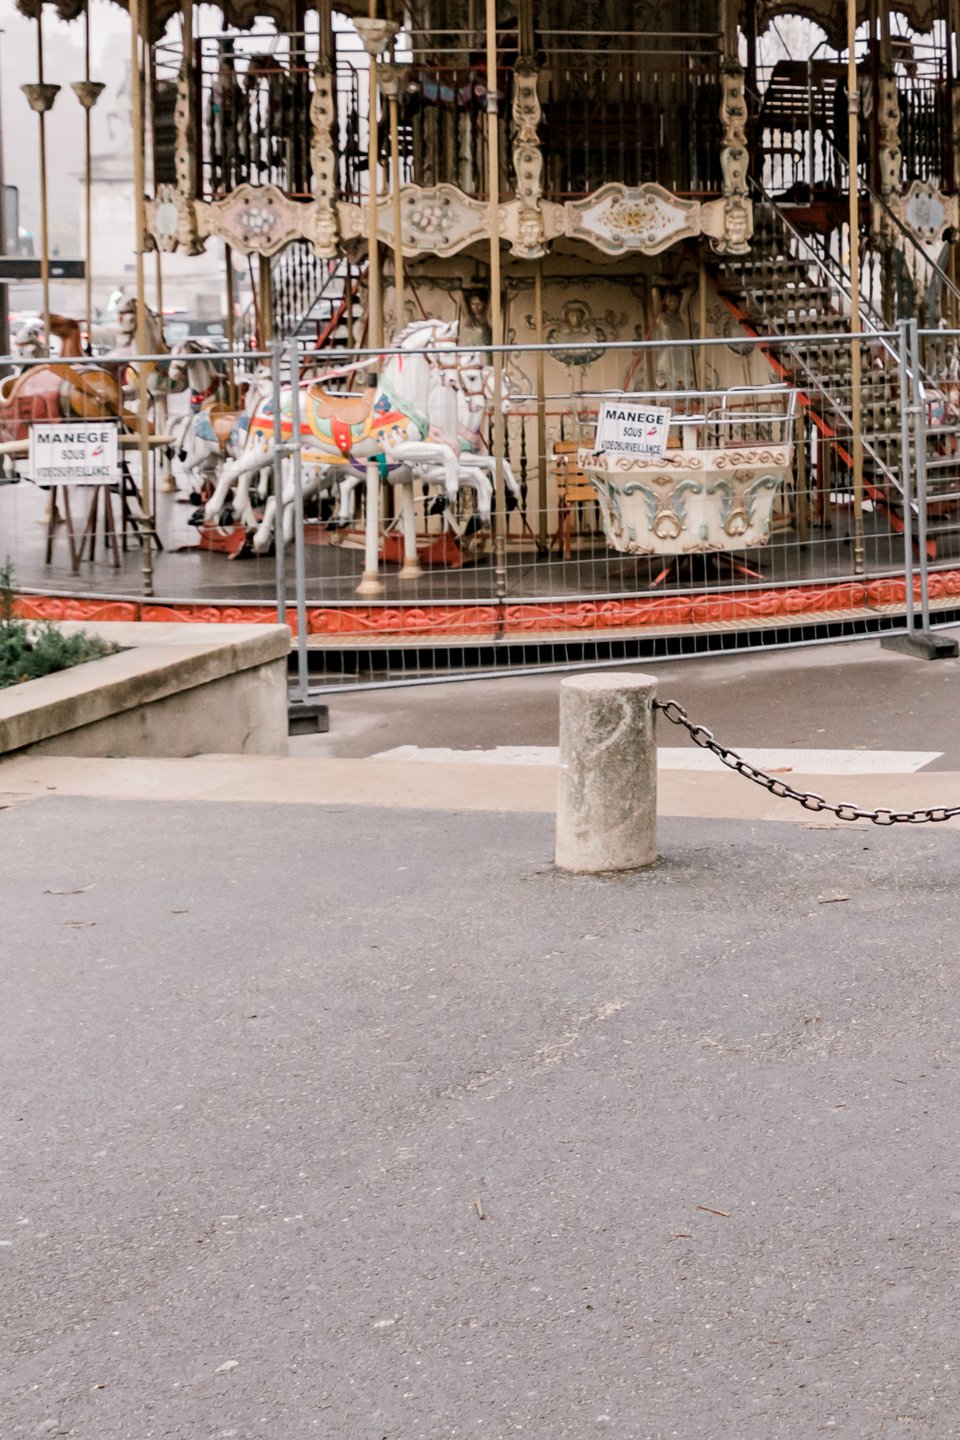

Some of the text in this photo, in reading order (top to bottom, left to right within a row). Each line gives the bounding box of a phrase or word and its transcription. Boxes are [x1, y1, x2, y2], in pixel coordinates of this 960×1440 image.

[605, 410, 663, 424] MANEGE
[37, 432, 109, 443] MANEGE
[623, 426, 643, 438] SOUS
[61, 449, 86, 460] SOUS
